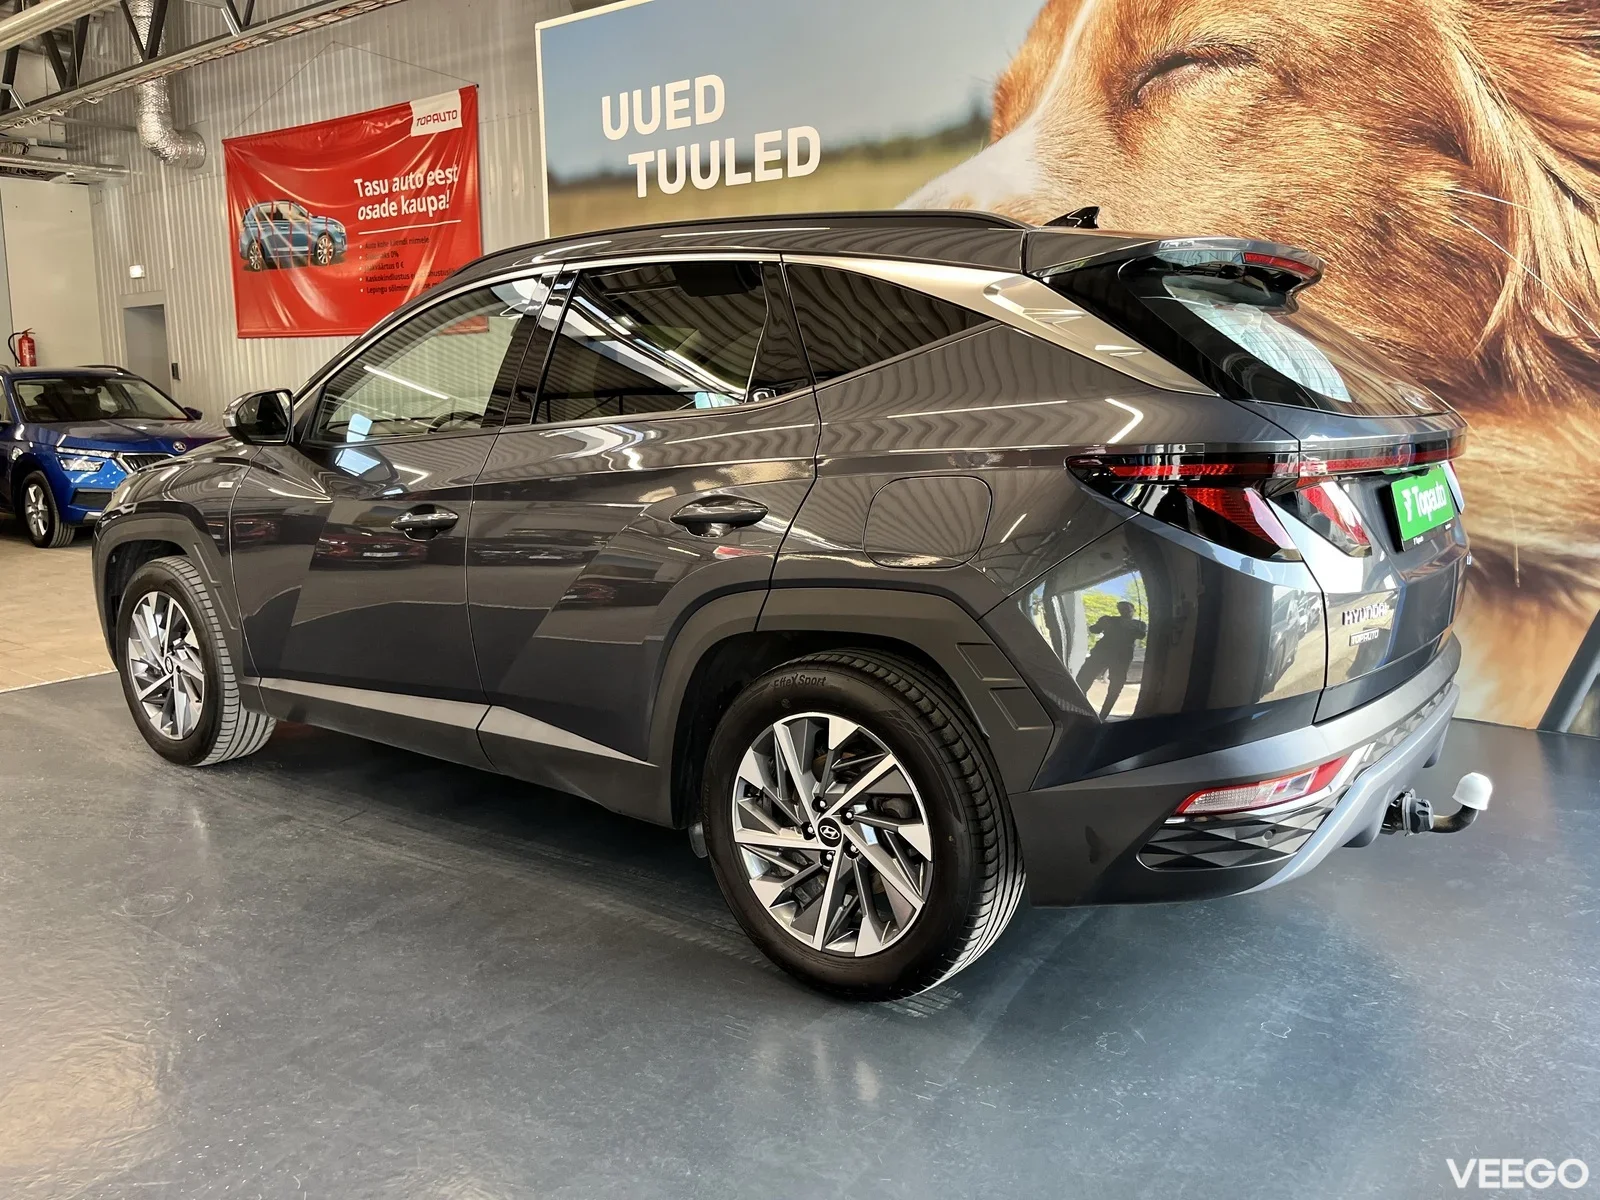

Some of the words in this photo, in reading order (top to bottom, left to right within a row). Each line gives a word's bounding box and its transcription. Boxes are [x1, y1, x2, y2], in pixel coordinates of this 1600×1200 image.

[416, 109, 458, 127] TOPAUTO
[601, 74, 725, 141] UUED
[628, 125, 821, 198] TUULED
[354, 178, 389, 198] Tasu
[392, 171, 424, 193] auto
[427, 164, 459, 187] eest
[358, 197, 398, 221] osade
[401, 189, 450, 218] kaupa!
[1411, 480, 1447, 522] Topauto
